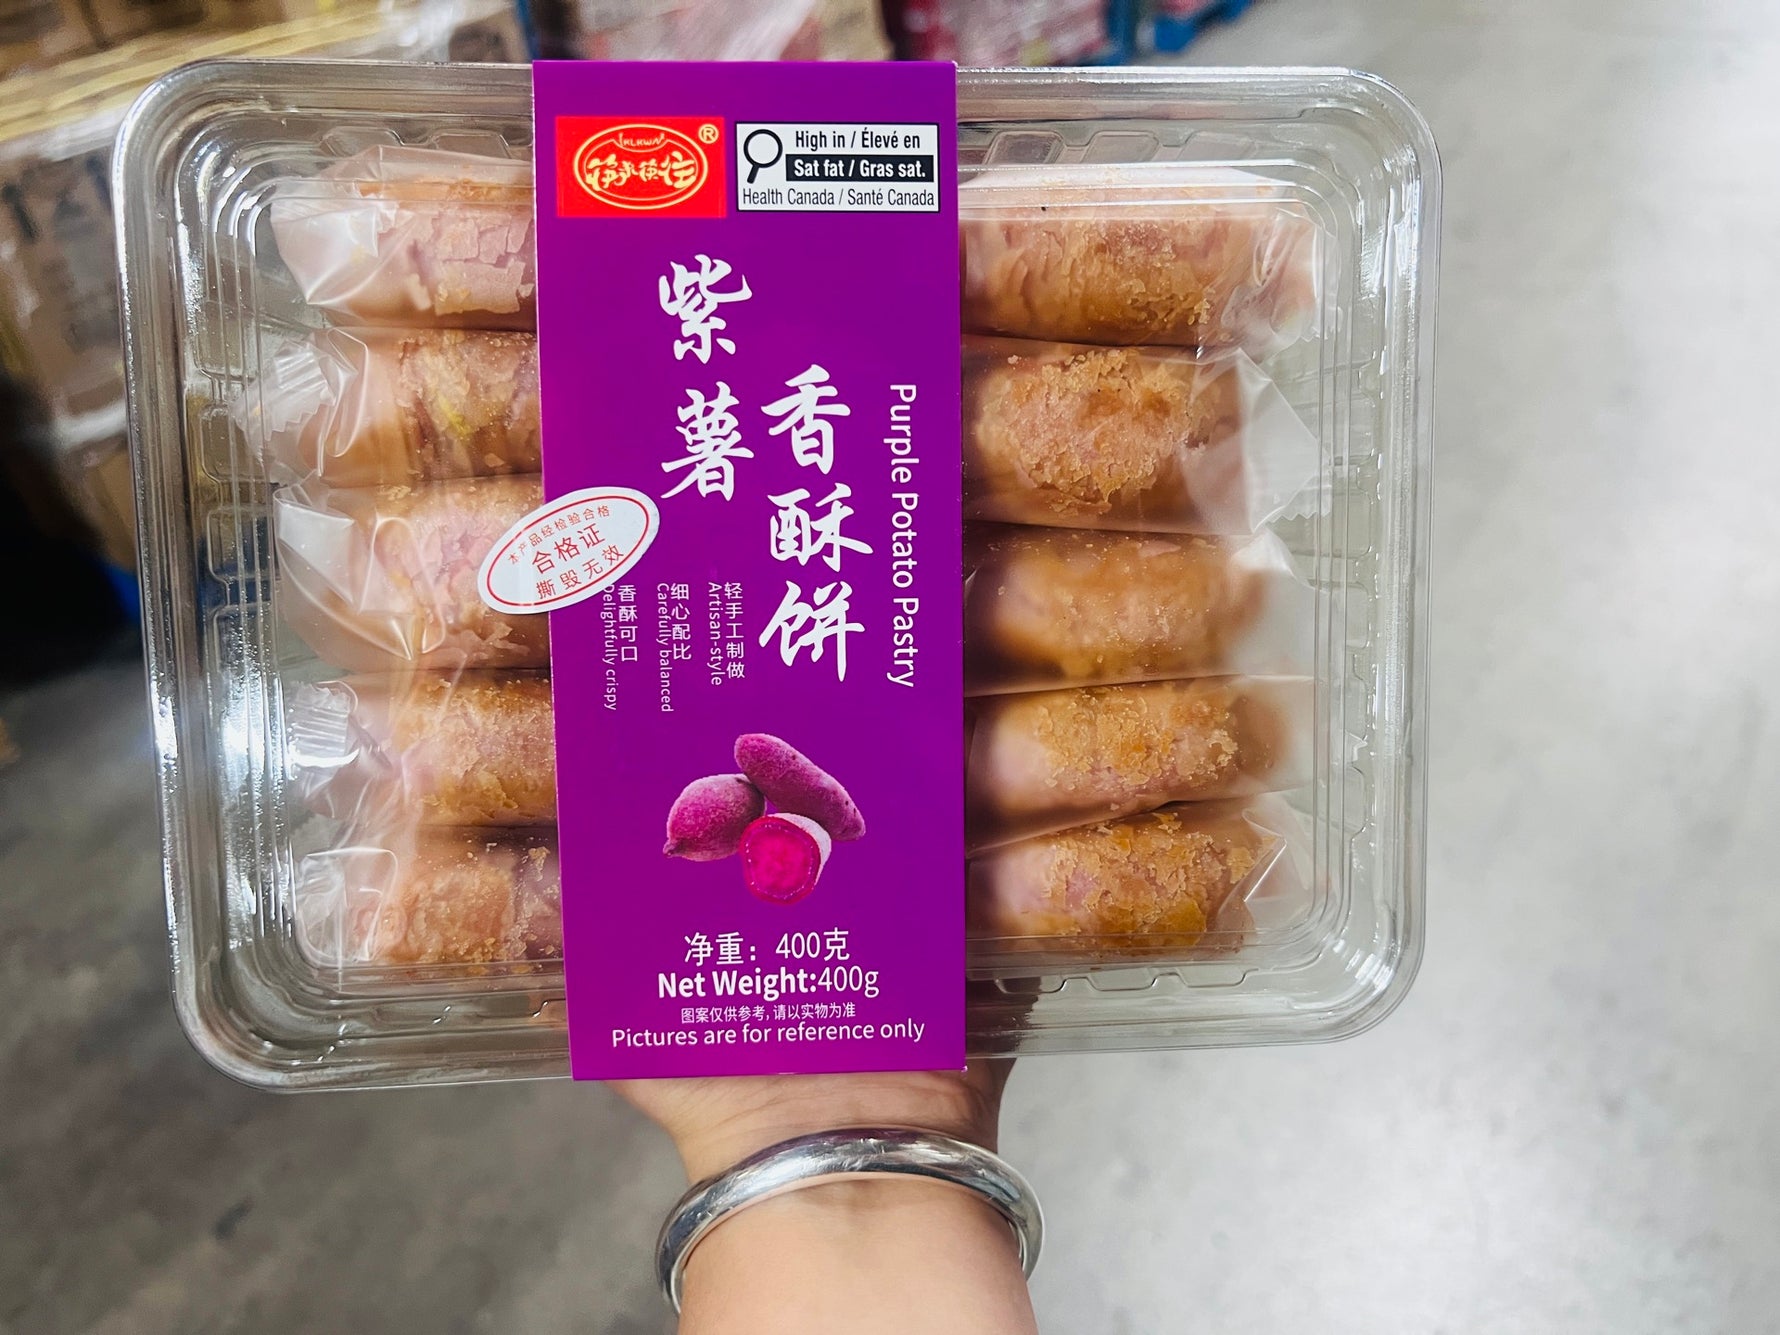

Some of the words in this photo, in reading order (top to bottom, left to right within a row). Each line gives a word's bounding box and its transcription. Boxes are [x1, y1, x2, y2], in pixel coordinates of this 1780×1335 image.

[794, 159, 820, 177] Sat
[823, 159, 845, 177] fat
[848, 159, 856, 177] /
[859, 160, 894, 178] Gras
[898, 161, 926, 178] sat.
[795, 130, 828, 152] High
[833, 130, 846, 149] in
[850, 130, 857, 149] /
[861, 127, 899, 149] Élevé
[903, 134, 921, 149] en
[743, 188, 783, 205] Health
[787, 188, 835, 206] Canada
[838, 188, 845, 206] /
[847, 188, 884, 206] Santé
[887, 188, 935, 206] Canada
[658, 253, 755, 502] 紫薯
[883, 384, 920, 484] Purple
[508, 504, 611, 565] 本产品经检验合格
[531, 522, 606, 575] 合格证
[759, 363, 874, 683] 香酥饼
[891, 493, 921, 589] Potato
[535, 543, 625, 600] 撕毁无效
[600, 584, 619, 665] Delightfully
[617, 584, 638, 662] 香酥可口
[656, 582, 672, 646] Carefully
[670, 582, 692, 661] 细心配比
[707, 582, 726, 685] Artisan-style
[724, 581, 745, 679] 轻手工制做
[886, 597, 920, 688] Pastry
[604, 669, 619, 710] crispy
[660, 649, 674, 712] balanced
[658, 971, 707, 999] Net
[612, 1026, 698, 1048] Pictures
[703, 1027, 738, 1044] are
[741, 1022, 773, 1043] for
[777, 1019, 876, 1042] reference
[880, 1017, 926, 1043] only
